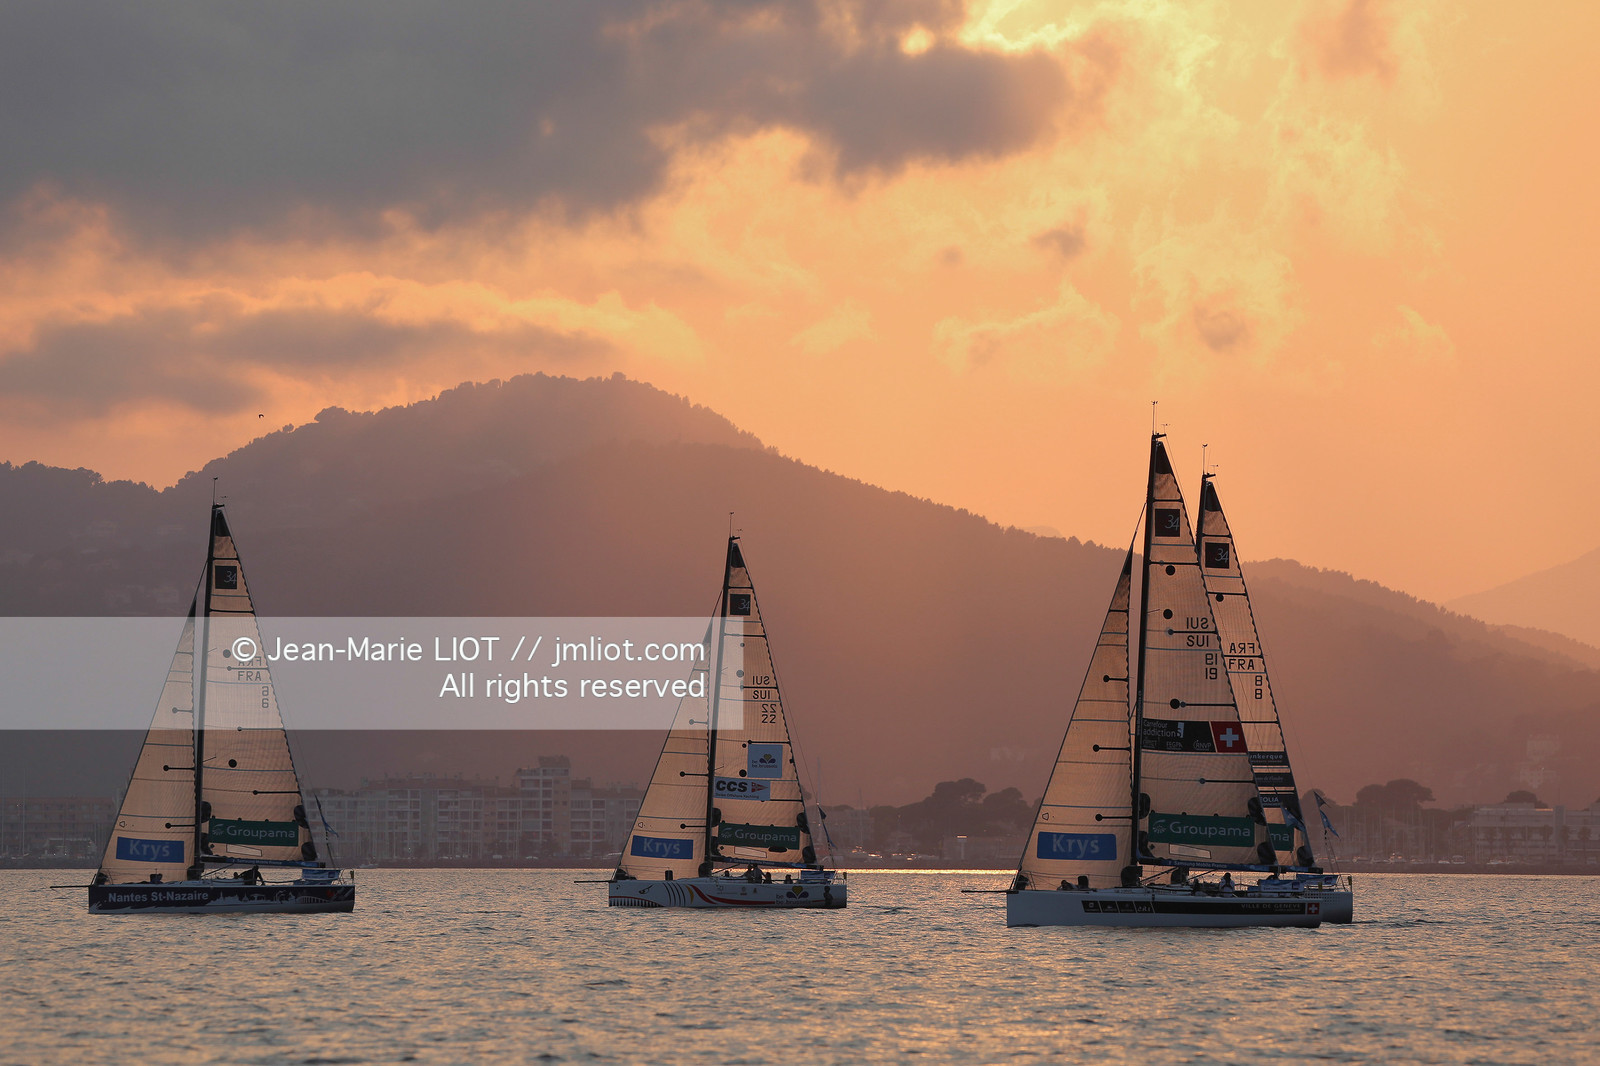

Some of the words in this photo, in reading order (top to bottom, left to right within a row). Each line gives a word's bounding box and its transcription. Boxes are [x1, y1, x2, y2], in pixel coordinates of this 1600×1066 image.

[1164, 514, 1180, 531] 34
[1215, 548, 1229, 563] 34
[223, 570, 237, 584] 34
[738, 599, 750, 611] 34
[1186, 635, 1209, 647] SUI
[1228, 658, 1255, 670] FRA
[237, 670, 262, 682] FRA
[1205, 668, 1218, 680] 19
[752, 690, 771, 700] SUI
[1255, 688, 1262, 700] 8
[261, 697, 269, 709] 6
[761, 714, 777, 724] 22
[716, 780, 748, 793] CCS
[226, 824, 296, 840] Groupama
[734, 829, 798, 843] Groupama
[1169, 821, 1251, 839] Groupama
[129, 838, 171, 860] Krys
[643, 837, 681, 858] Krys
[1052, 833, 1100, 859] Krys
[108, 892, 148, 903] Nantes
[150, 890, 209, 901] St-Nazaire
